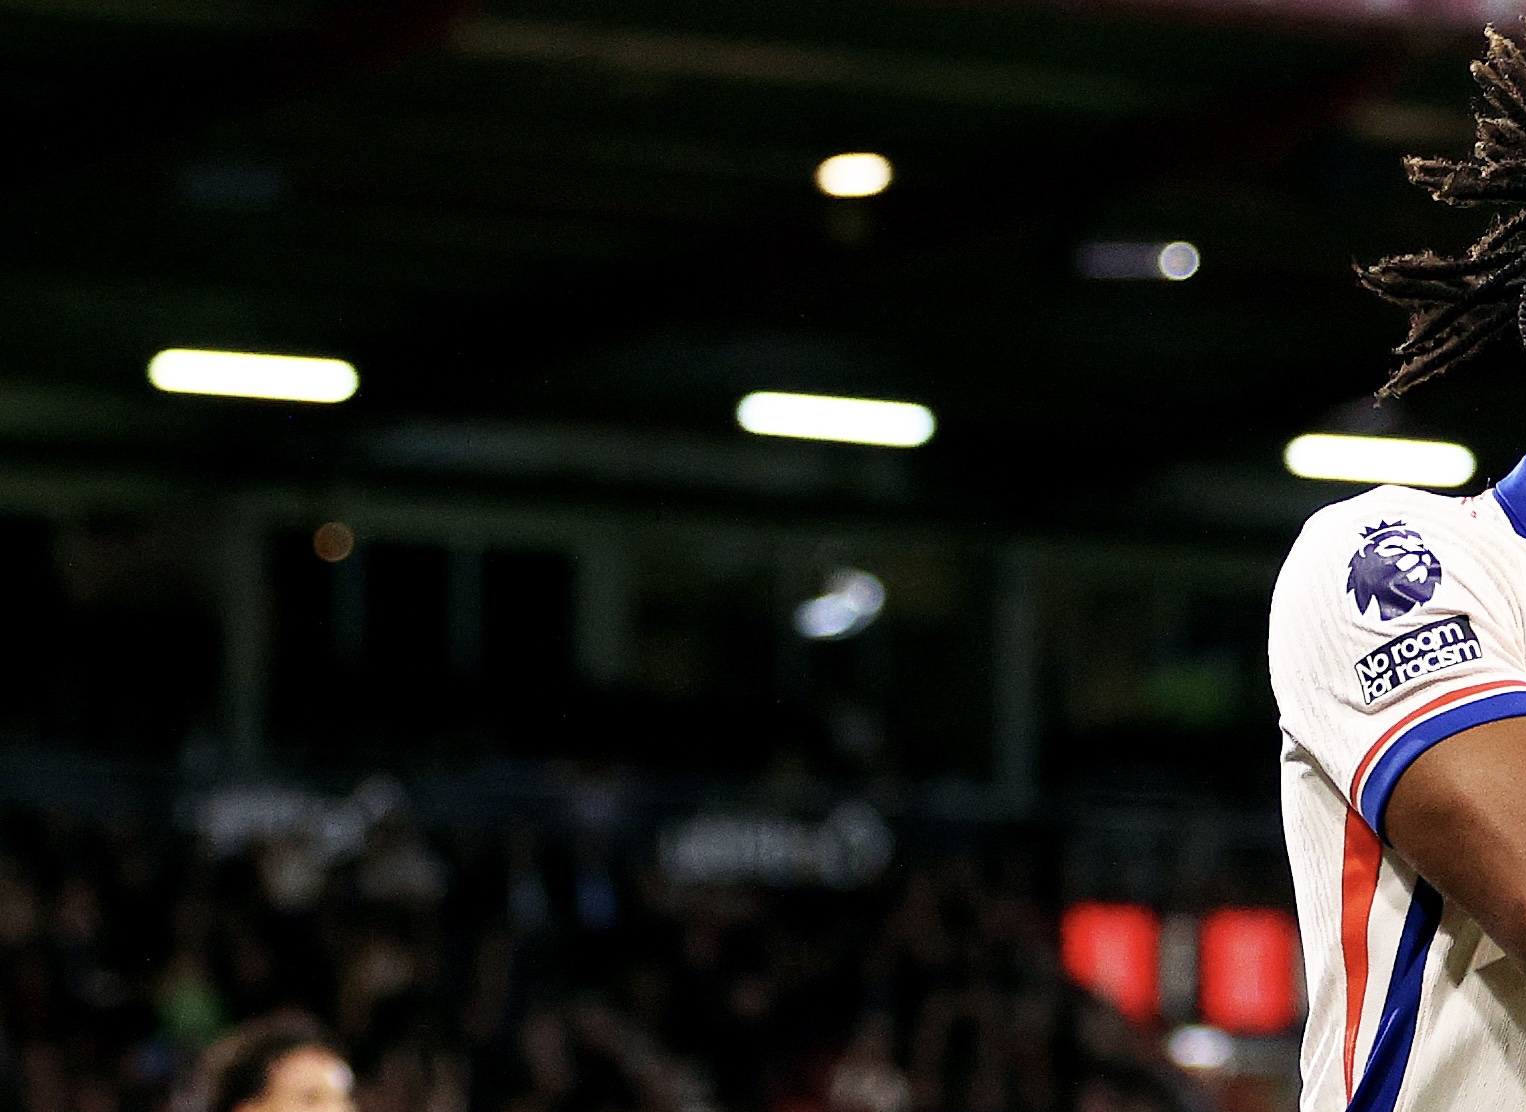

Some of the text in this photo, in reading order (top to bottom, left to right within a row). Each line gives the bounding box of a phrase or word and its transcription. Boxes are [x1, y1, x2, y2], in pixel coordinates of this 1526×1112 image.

[1355, 623, 1464, 681] No room
[1362, 640, 1481, 704] for racism
